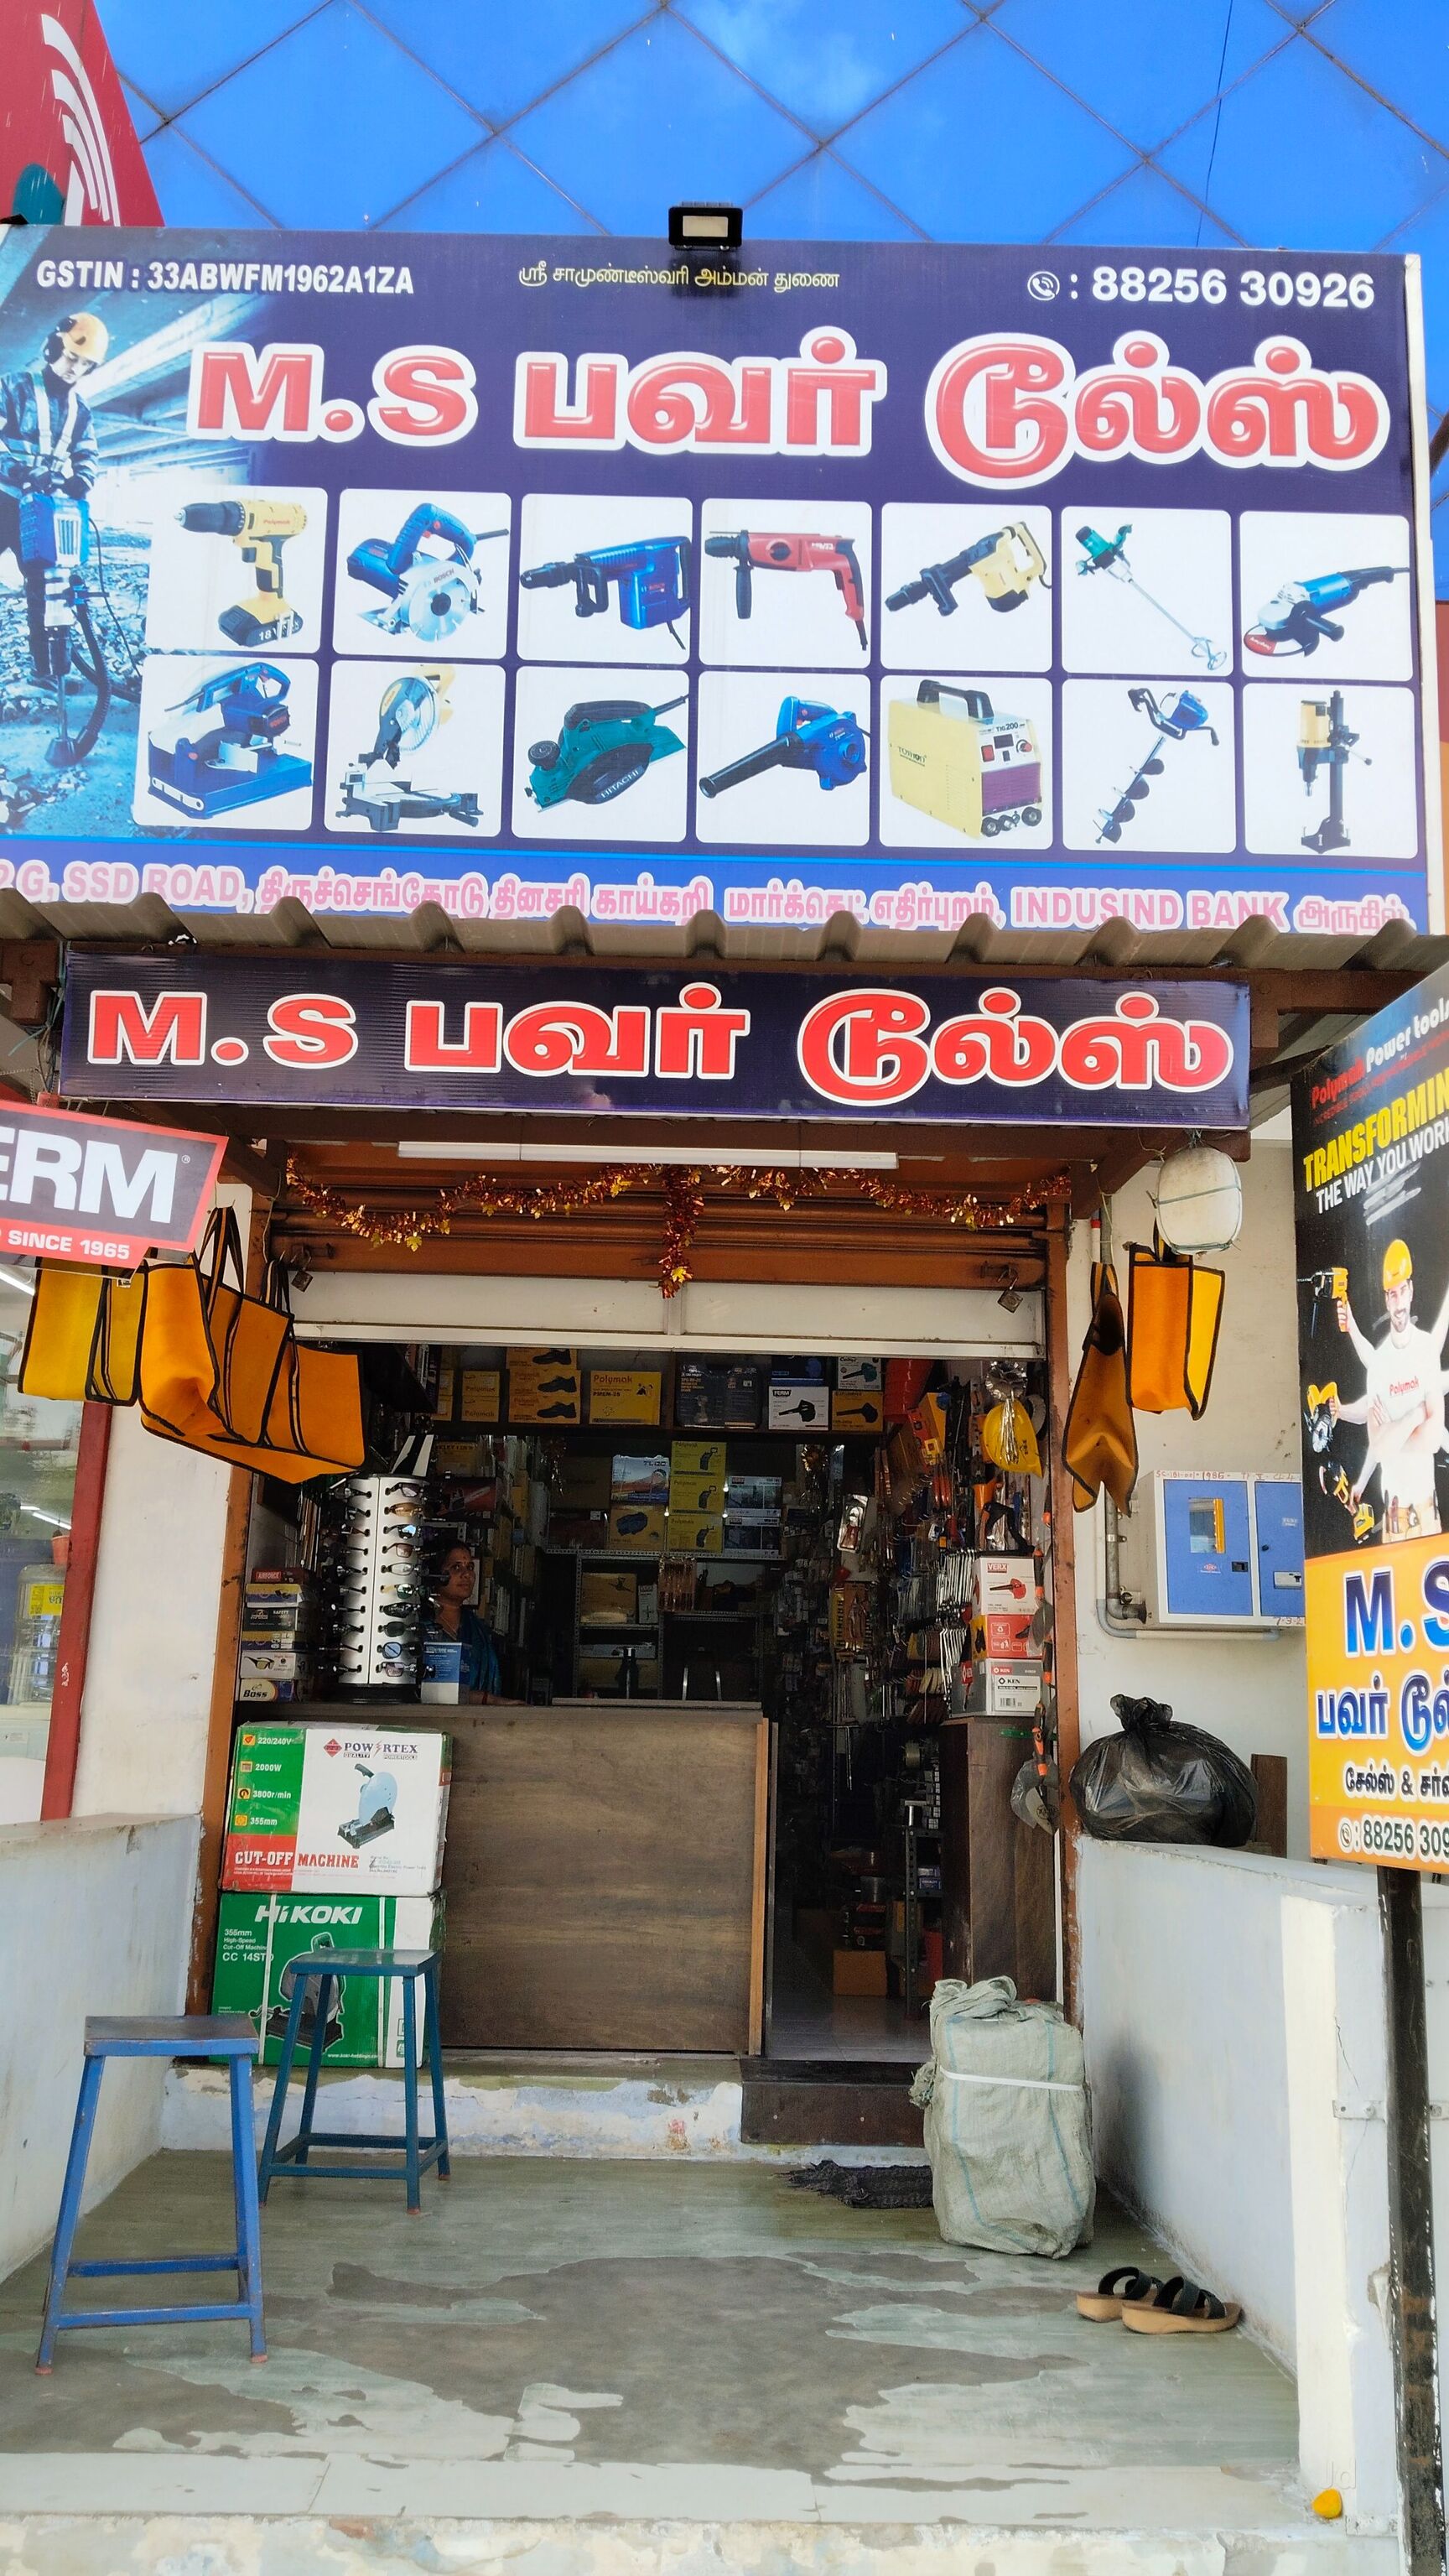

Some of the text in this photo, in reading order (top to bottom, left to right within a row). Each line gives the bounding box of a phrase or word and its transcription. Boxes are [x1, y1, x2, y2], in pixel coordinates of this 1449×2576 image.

[36, 260, 123, 289] GSTIN
[148, 262, 414, 295] 33ABWFM1962A1ZA
[553, 263, 689, 287] சாமுண்டீஸ்வரி
[694, 265, 769, 287] அம்மன்
[773, 271, 840, 293] துணை
[1092, 266, 1227, 305] 88256
[1239, 270, 1376, 310] 30926
[188, 325, 1389, 489] M.S பவர் டூல்ஸ்
[600, 769, 639, 799] HITACHI
[67, 866, 134, 900] SSD
[147, 868, 251, 908] ROAD,
[1015, 891, 1179, 926] INDUSIND
[1192, 895, 1286, 929] BANK
[88, 981, 1234, 1106] M.S பவர் டூல்ஸ்
[1366, 1026, 1411, 1074] Power
[1316, 1183, 1343, 1214] THE
[1343, 1160, 1374, 1200] WAY
[1376, 1142, 1407, 1178] YOU
[8, 1229, 130, 1260] SINCE 1965
[593, 1374, 632, 1384] Polymak
[1389, 1376, 1420, 1396] Polymak
[1316, 1672, 1391, 1741] பவர்
[257, 1736, 292, 1745] 220/240V
[255, 1763, 282, 1772] 2000W
[1345, 1763, 1395, 1794] சேல்ஸ்
[1400, 1770, 1415, 1796] &
[252, 1789, 292, 1799] 3800r/min
[250, 1816, 278, 1826] 355mm
[1363, 1819, 1415, 1855] 88256
[235, 1850, 293, 1866] CUT-OFF
[297, 1852, 360, 1868] MACHINE
[224, 1928, 252, 1936] 355mm
[222, 1952, 238, 1961] CC
